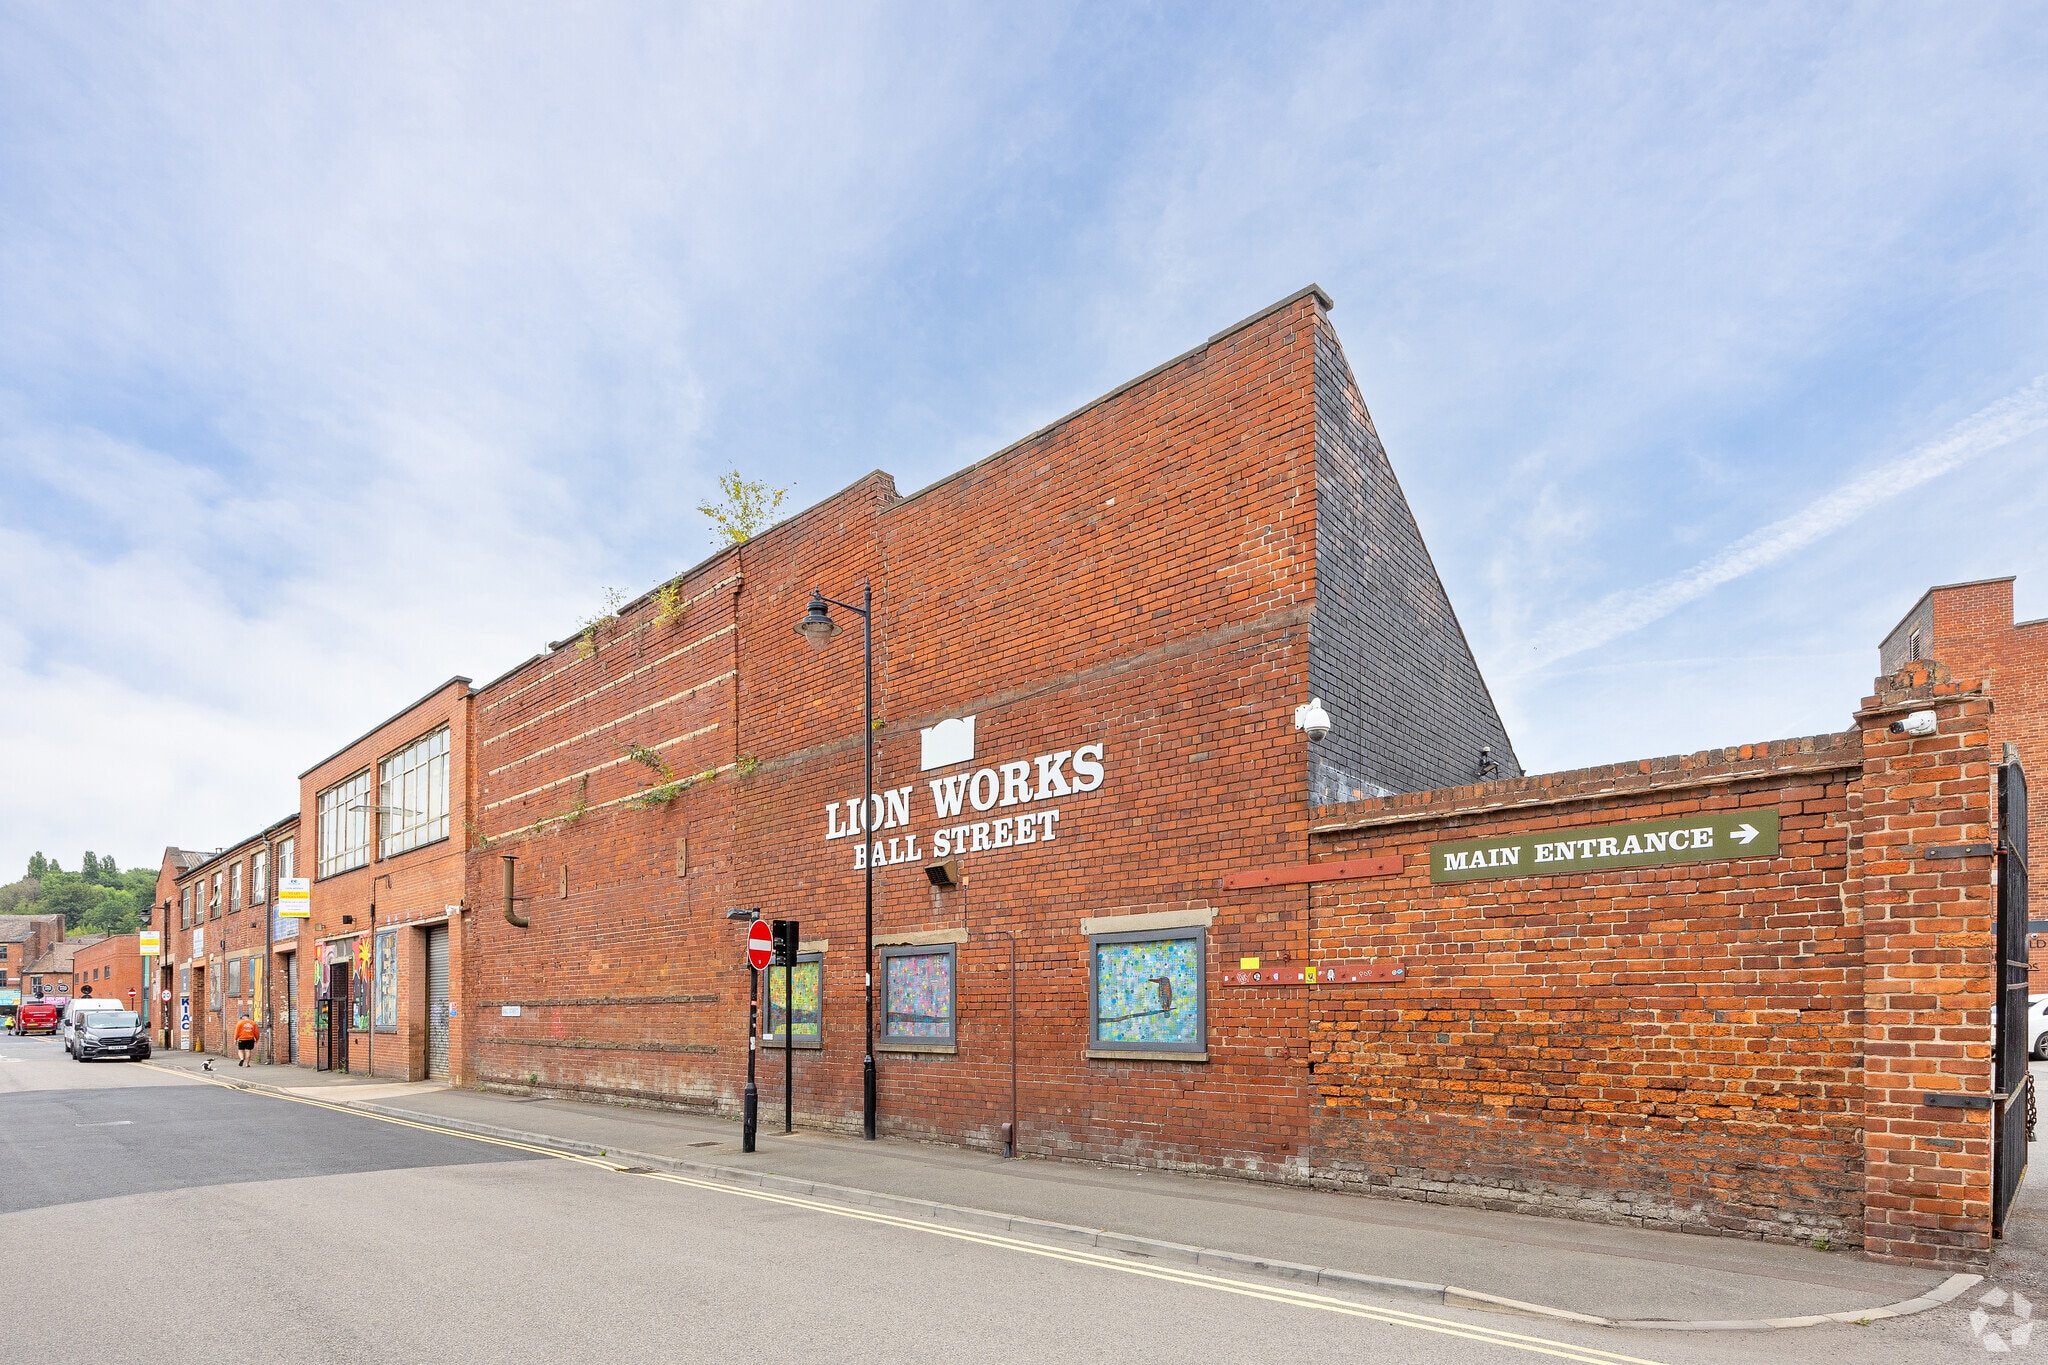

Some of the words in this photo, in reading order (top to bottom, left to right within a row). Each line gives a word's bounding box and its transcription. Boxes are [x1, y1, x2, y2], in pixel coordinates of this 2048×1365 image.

[825, 785, 913, 840] LION
[929, 743, 1105, 818] WORKS
[853, 834, 922, 870] BALL
[933, 809, 1060, 858] STREET
[1443, 846, 1521, 872] MAIN
[1534, 827, 1714, 864] ENTRANCE
[181, 998, 190, 1031] KIAC
